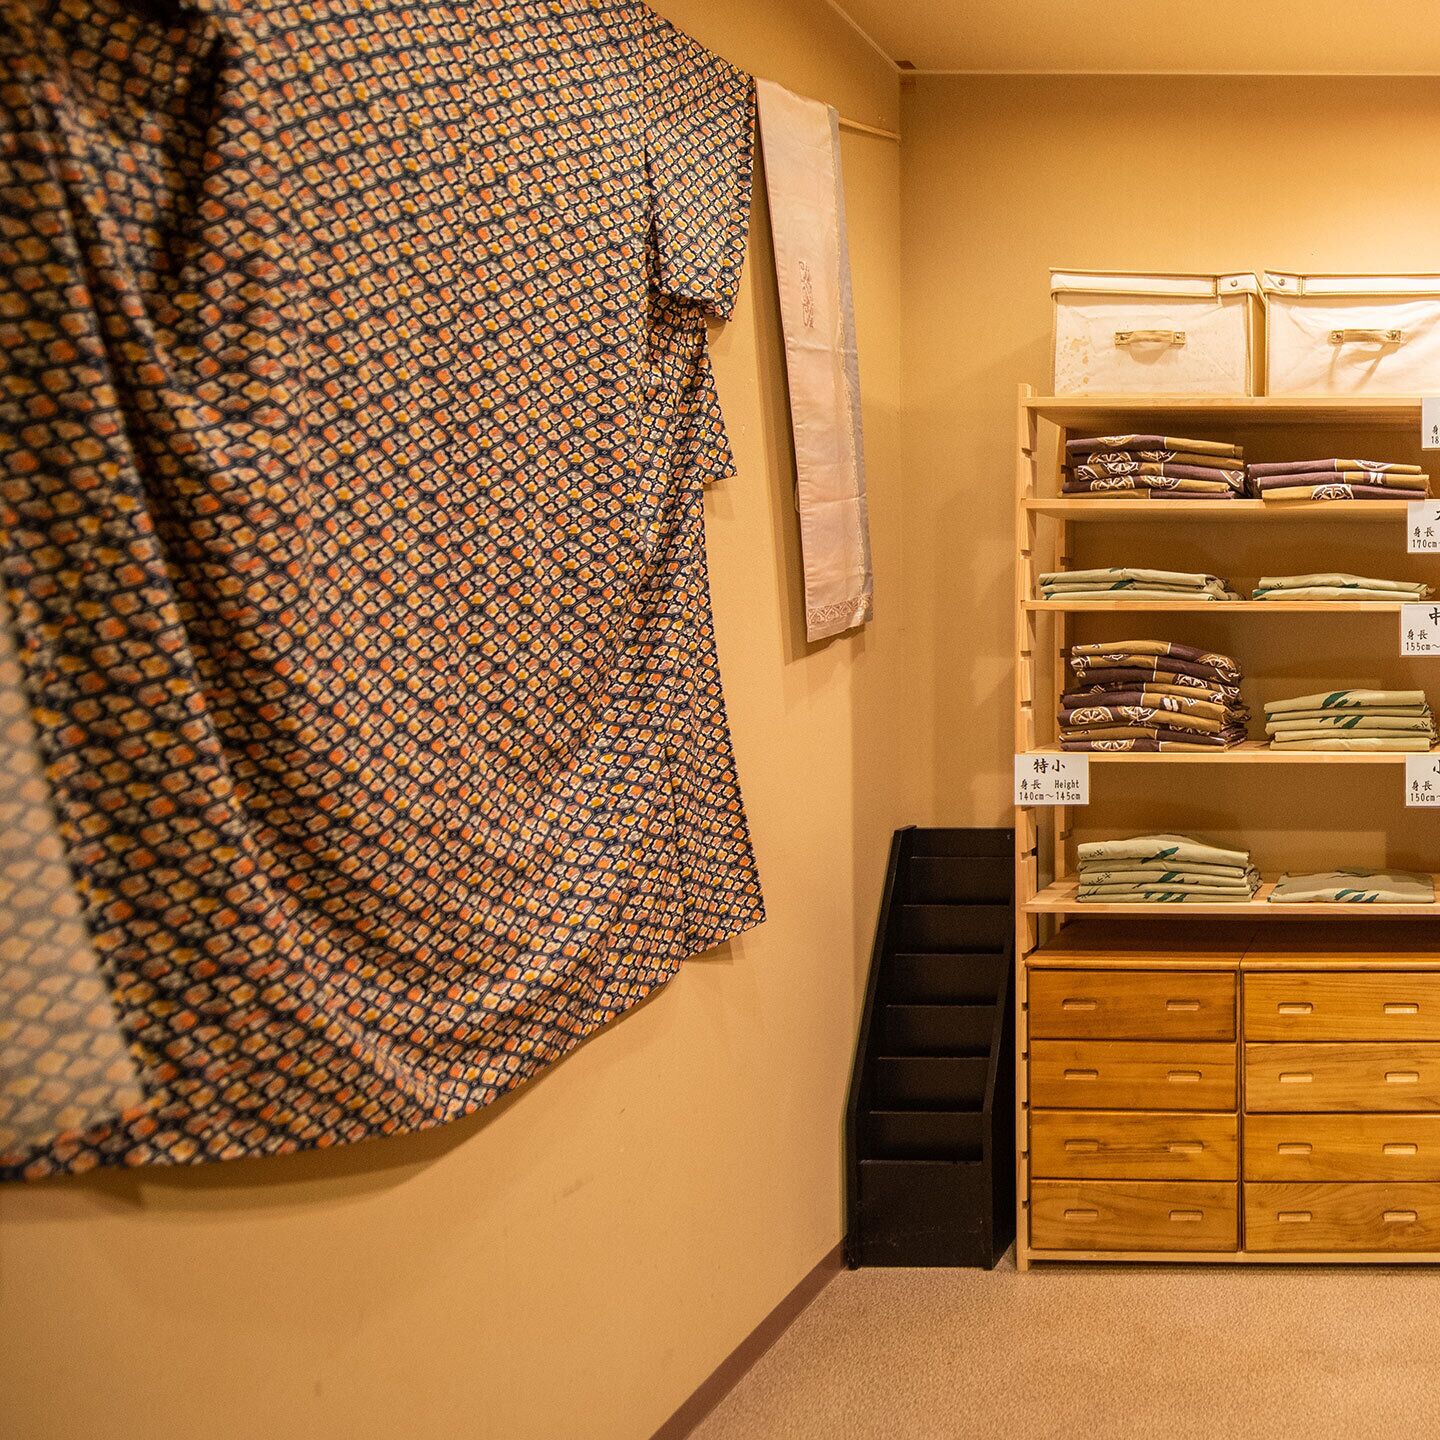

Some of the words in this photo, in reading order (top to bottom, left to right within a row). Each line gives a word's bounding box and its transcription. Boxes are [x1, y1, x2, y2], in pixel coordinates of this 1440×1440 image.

[1413, 526, 1434, 538] 身長
[1407, 629, 1428, 640] 身長
[1033, 758, 1066, 774] 特小
[1020, 779, 1041, 790] 身長
[1054, 779, 1080, 790] Height
[1412, 780, 1432, 791] 身長
